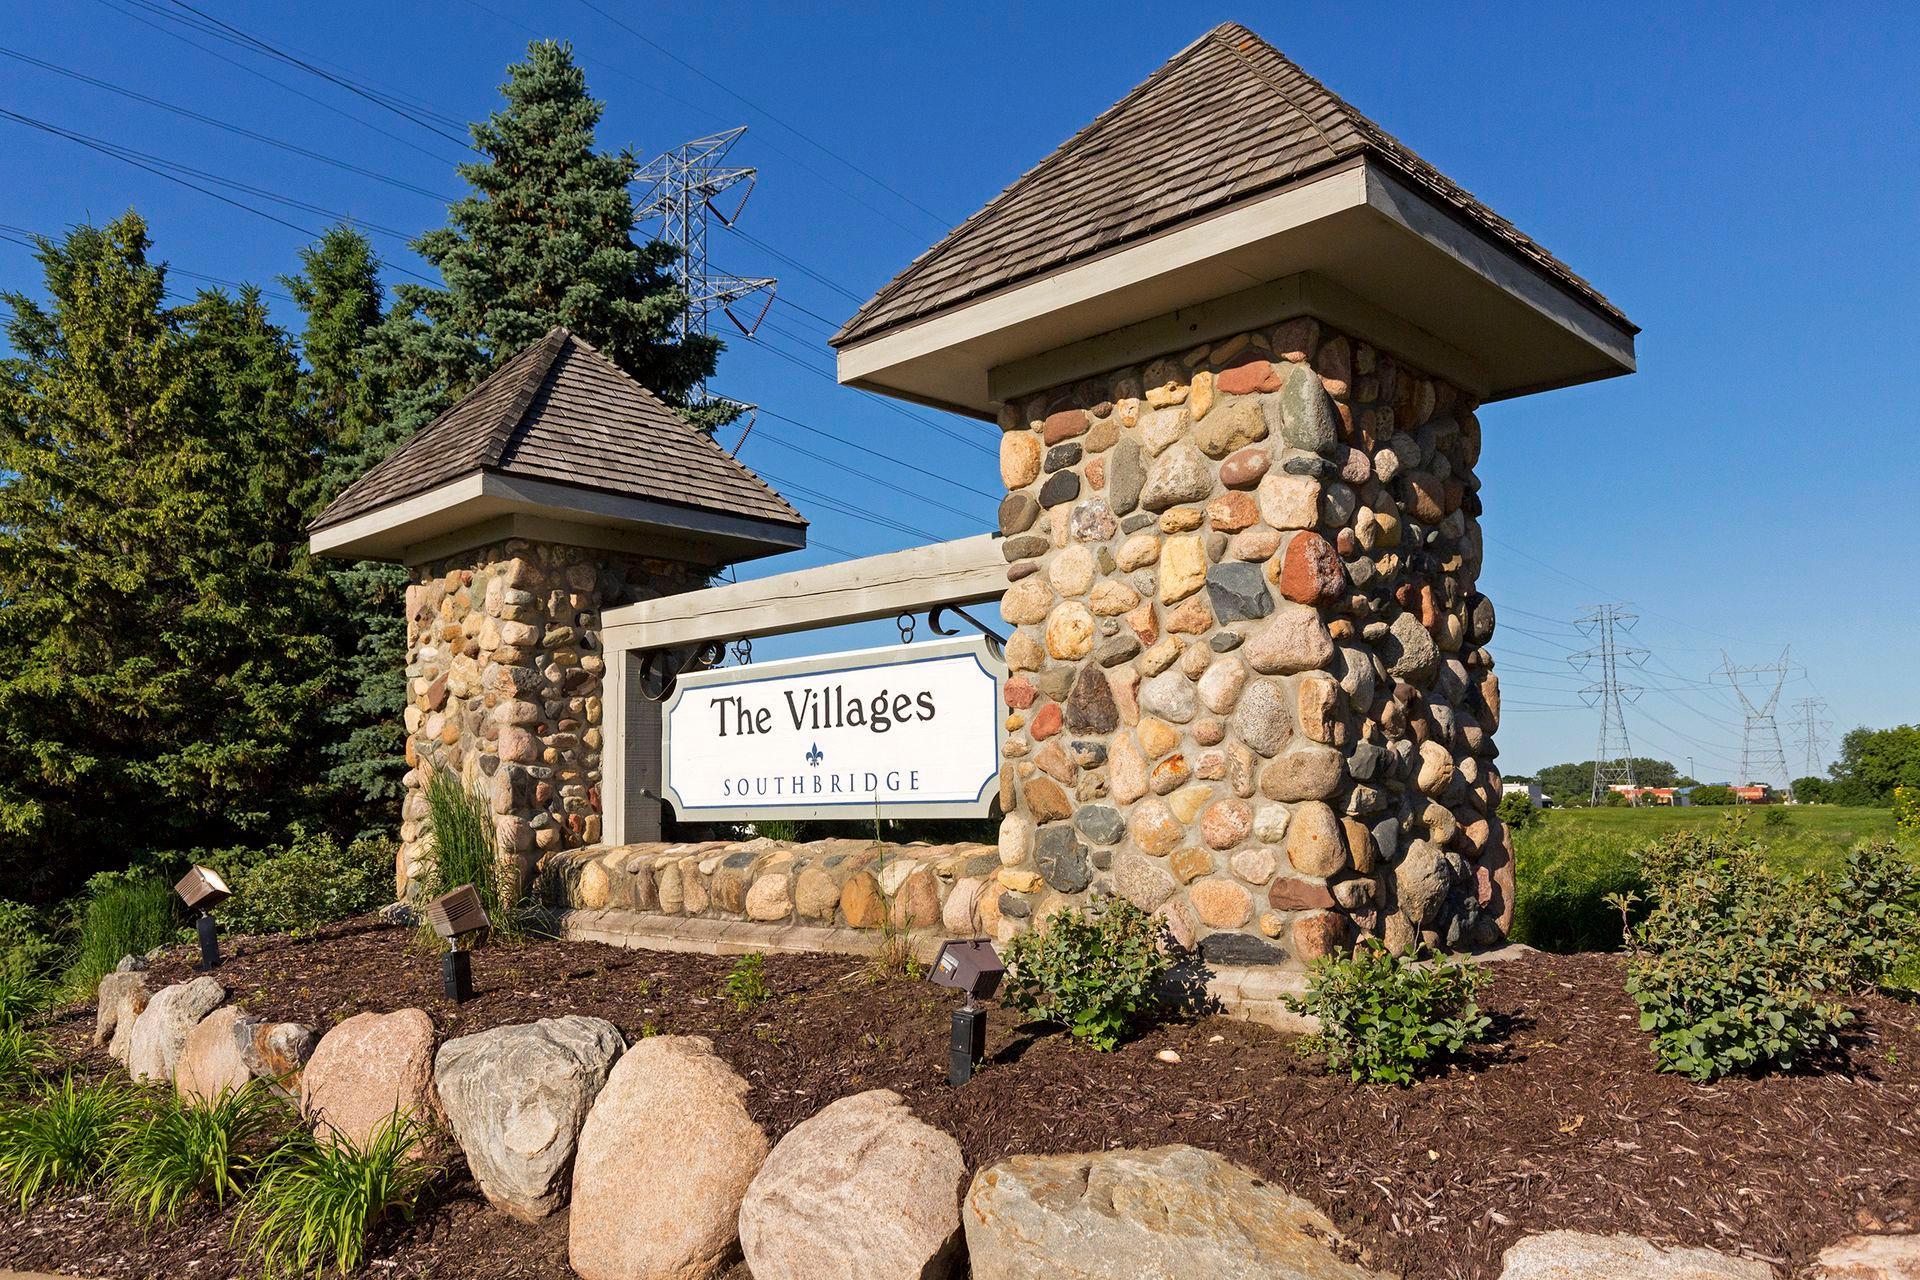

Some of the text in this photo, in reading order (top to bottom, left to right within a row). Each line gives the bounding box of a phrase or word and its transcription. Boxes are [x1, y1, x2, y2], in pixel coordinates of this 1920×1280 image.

[708, 684, 937, 738] The Villages
[723, 770, 920, 798] SOUTHBRIDGE
